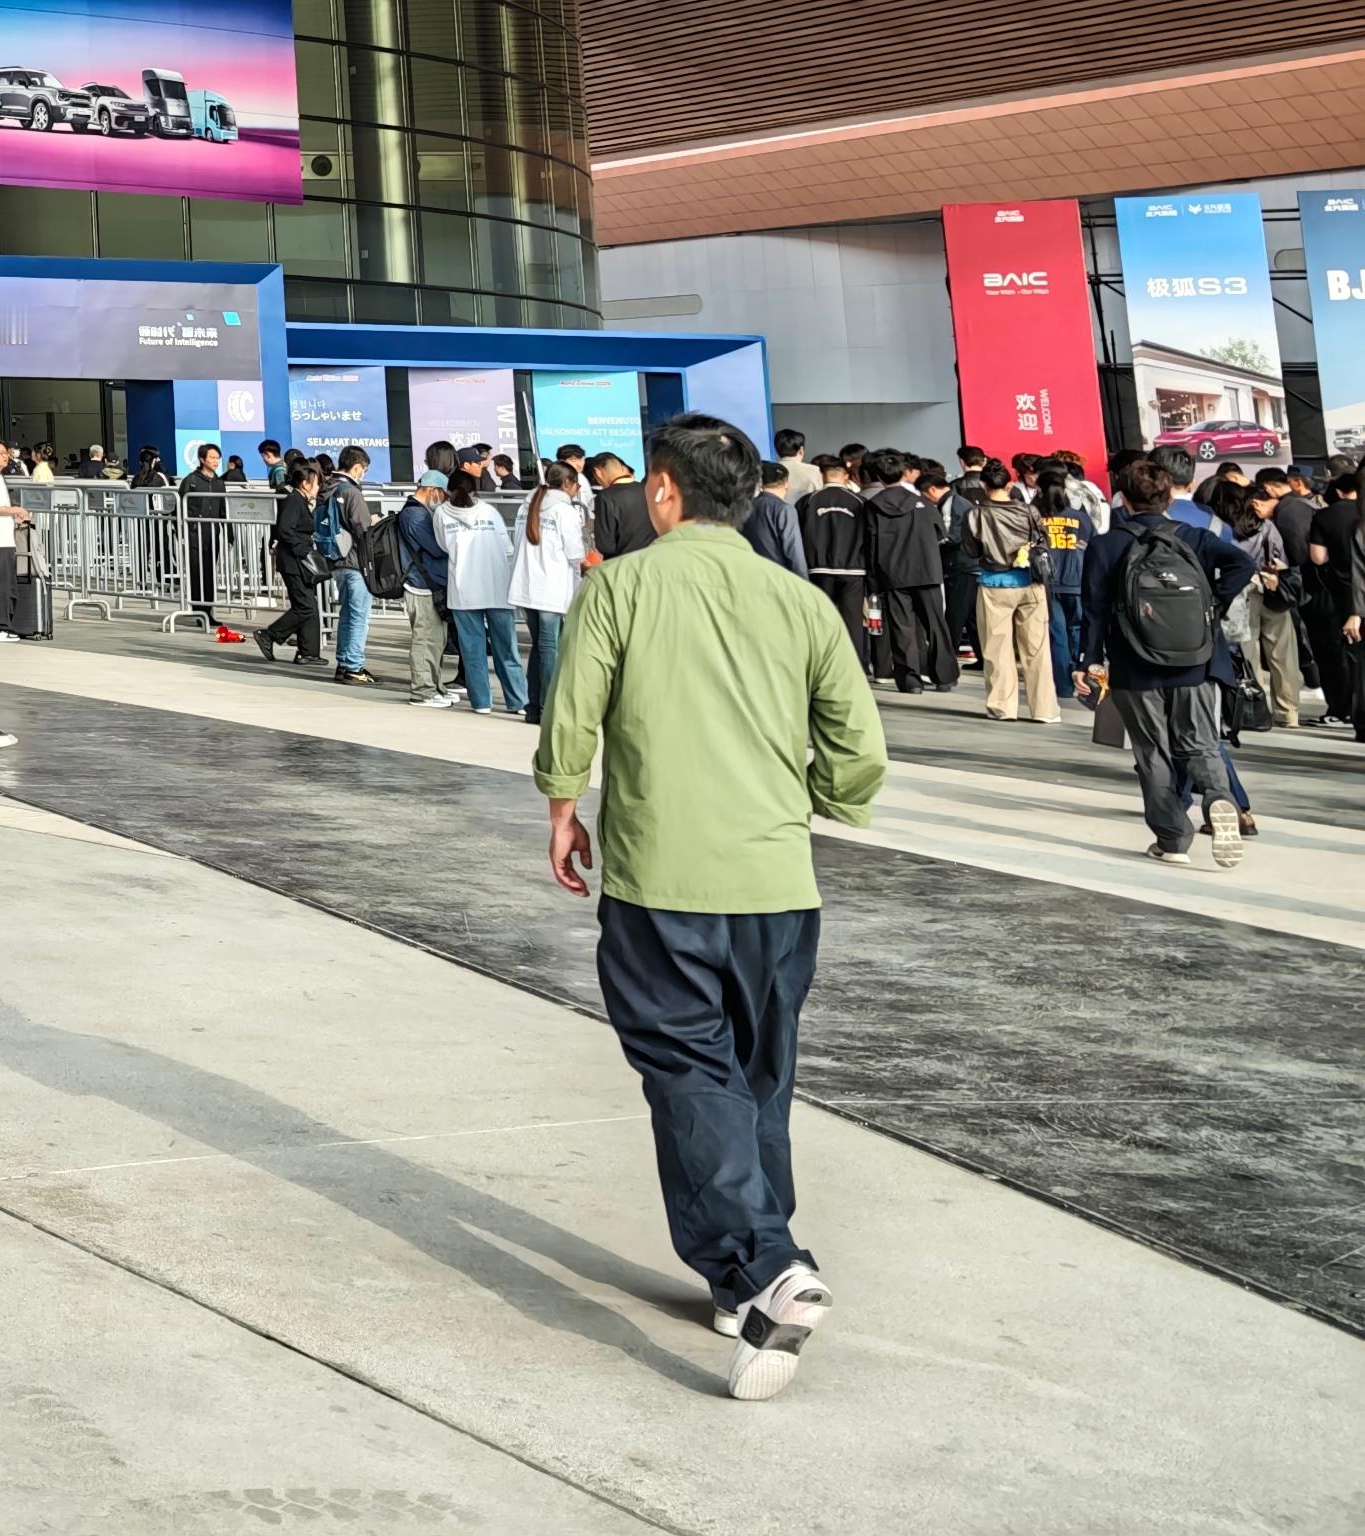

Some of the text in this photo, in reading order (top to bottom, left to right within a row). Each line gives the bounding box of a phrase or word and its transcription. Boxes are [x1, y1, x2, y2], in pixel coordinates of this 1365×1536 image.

[983, 271, 1048, 287] BAIC
[1147, 276, 1247, 298] 极狐S3
[139, 337, 163, 345] Future
[174, 338, 218, 348] Intelligence
[1015, 392, 1039, 431] 欢迎
[307, 437, 389, 448] SELAMAT DATANG
